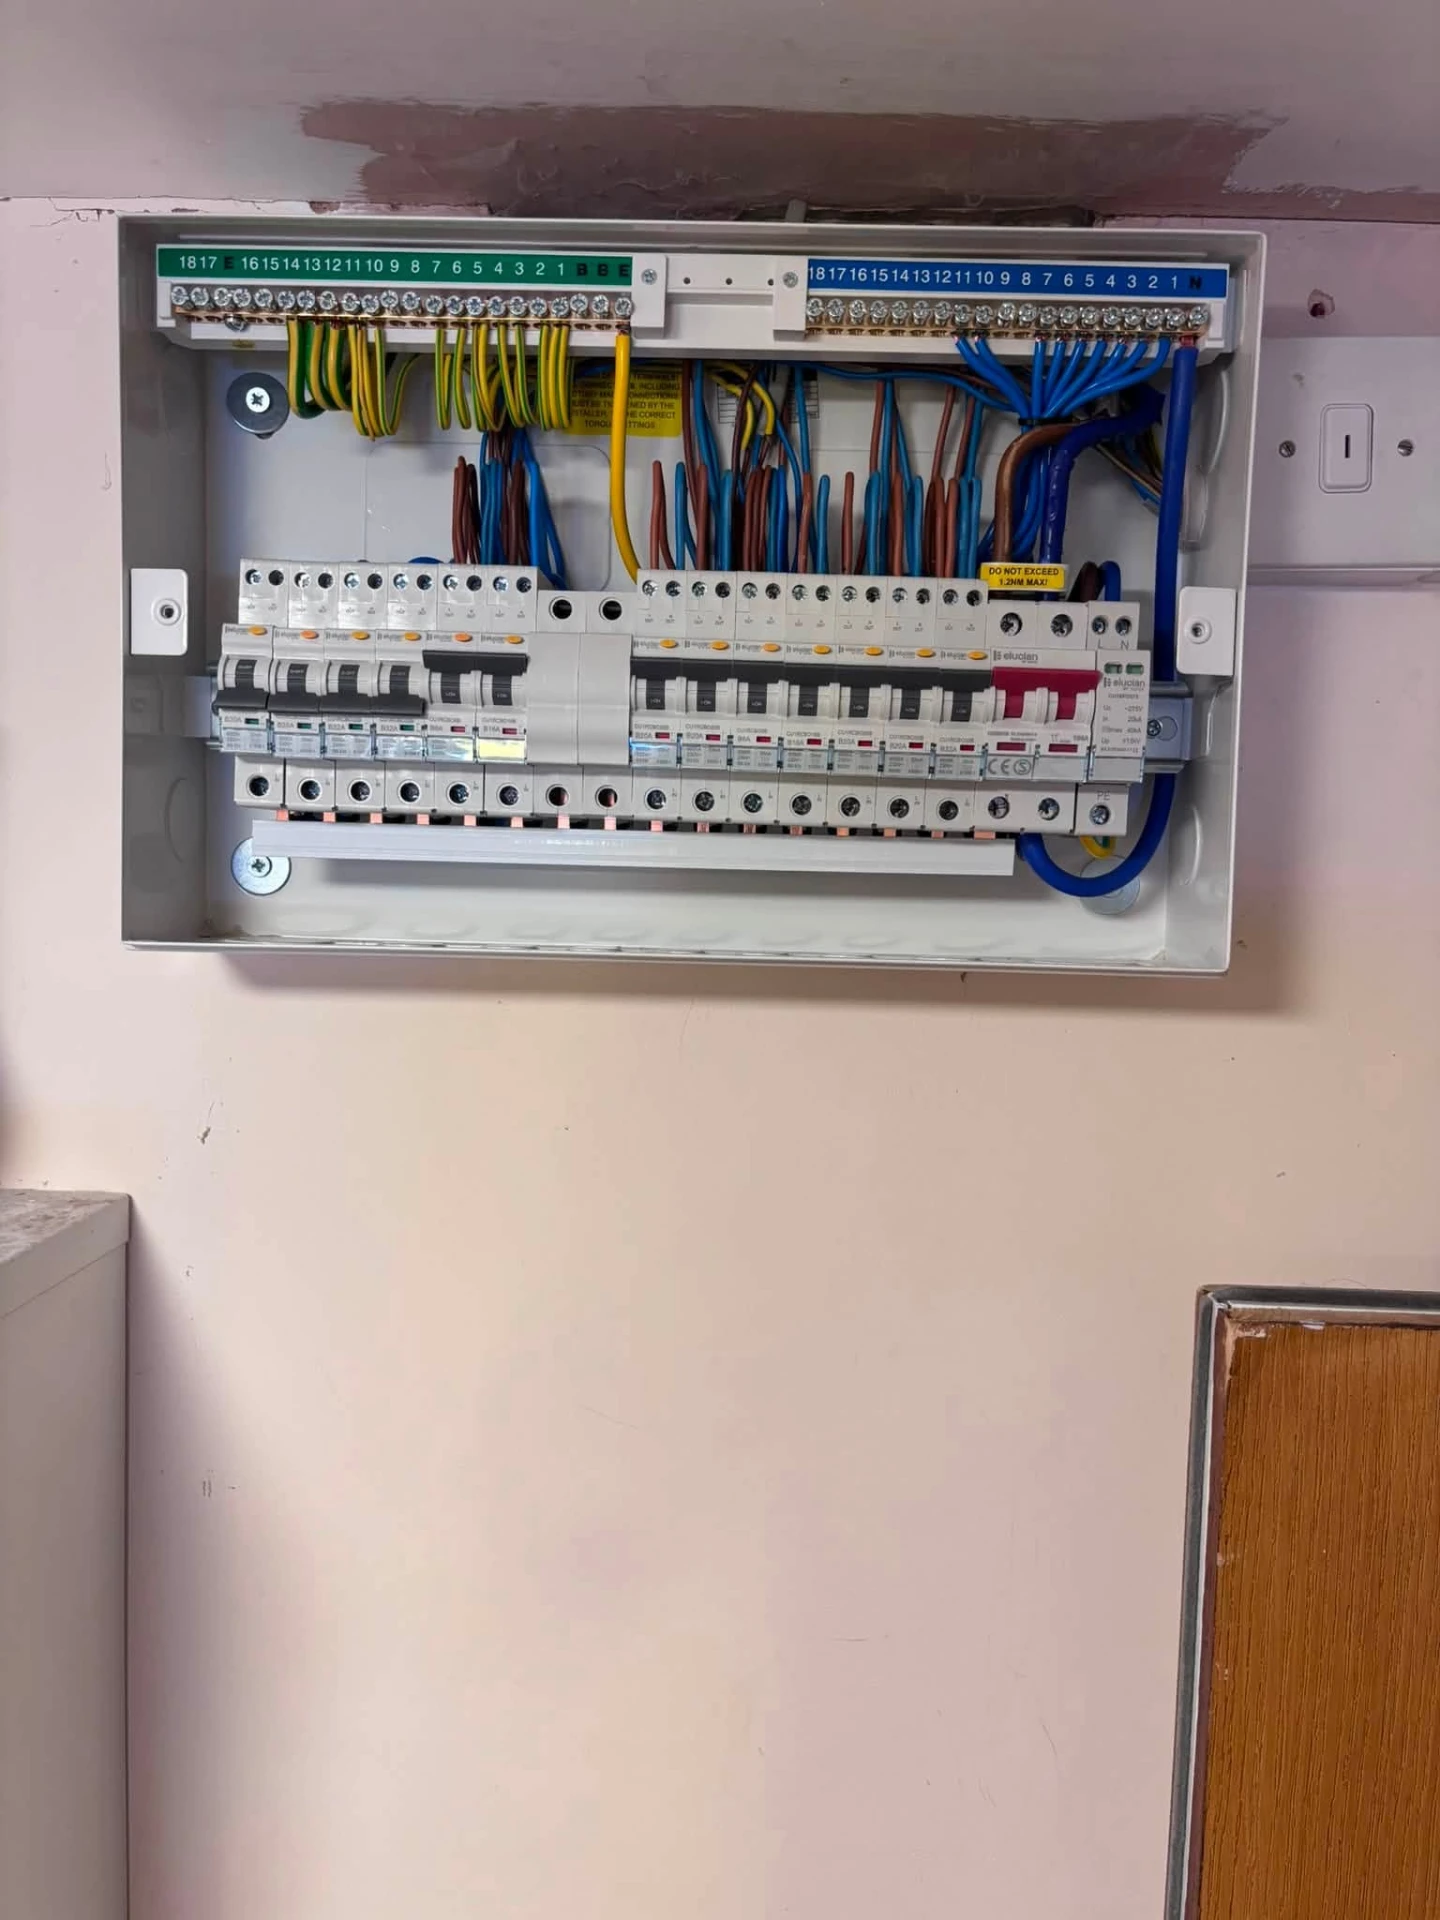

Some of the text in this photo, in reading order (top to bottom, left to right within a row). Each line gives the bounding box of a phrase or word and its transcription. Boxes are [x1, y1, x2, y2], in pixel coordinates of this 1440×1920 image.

[180, 256, 630, 277] 18 17 E 16 15 14 13 12 11 10 9 8 7 6 5 4 3 2 1 B B E
[809, 266, 1201, 289] 18 17 16 15 14 13 12 11 10 9 8 7 6 5 4 3 2 1 N
[989, 567, 1060, 576] DO NOT EXCEED
[1000, 578, 1024, 586] 1.2NM
[1120, 640, 1129, 651] N
[1003, 651, 1039, 660] elucian
[1113, 677, 1146, 687] elucian
[988, 758, 1011, 775] CE
[1097, 790, 1110, 801] PE
